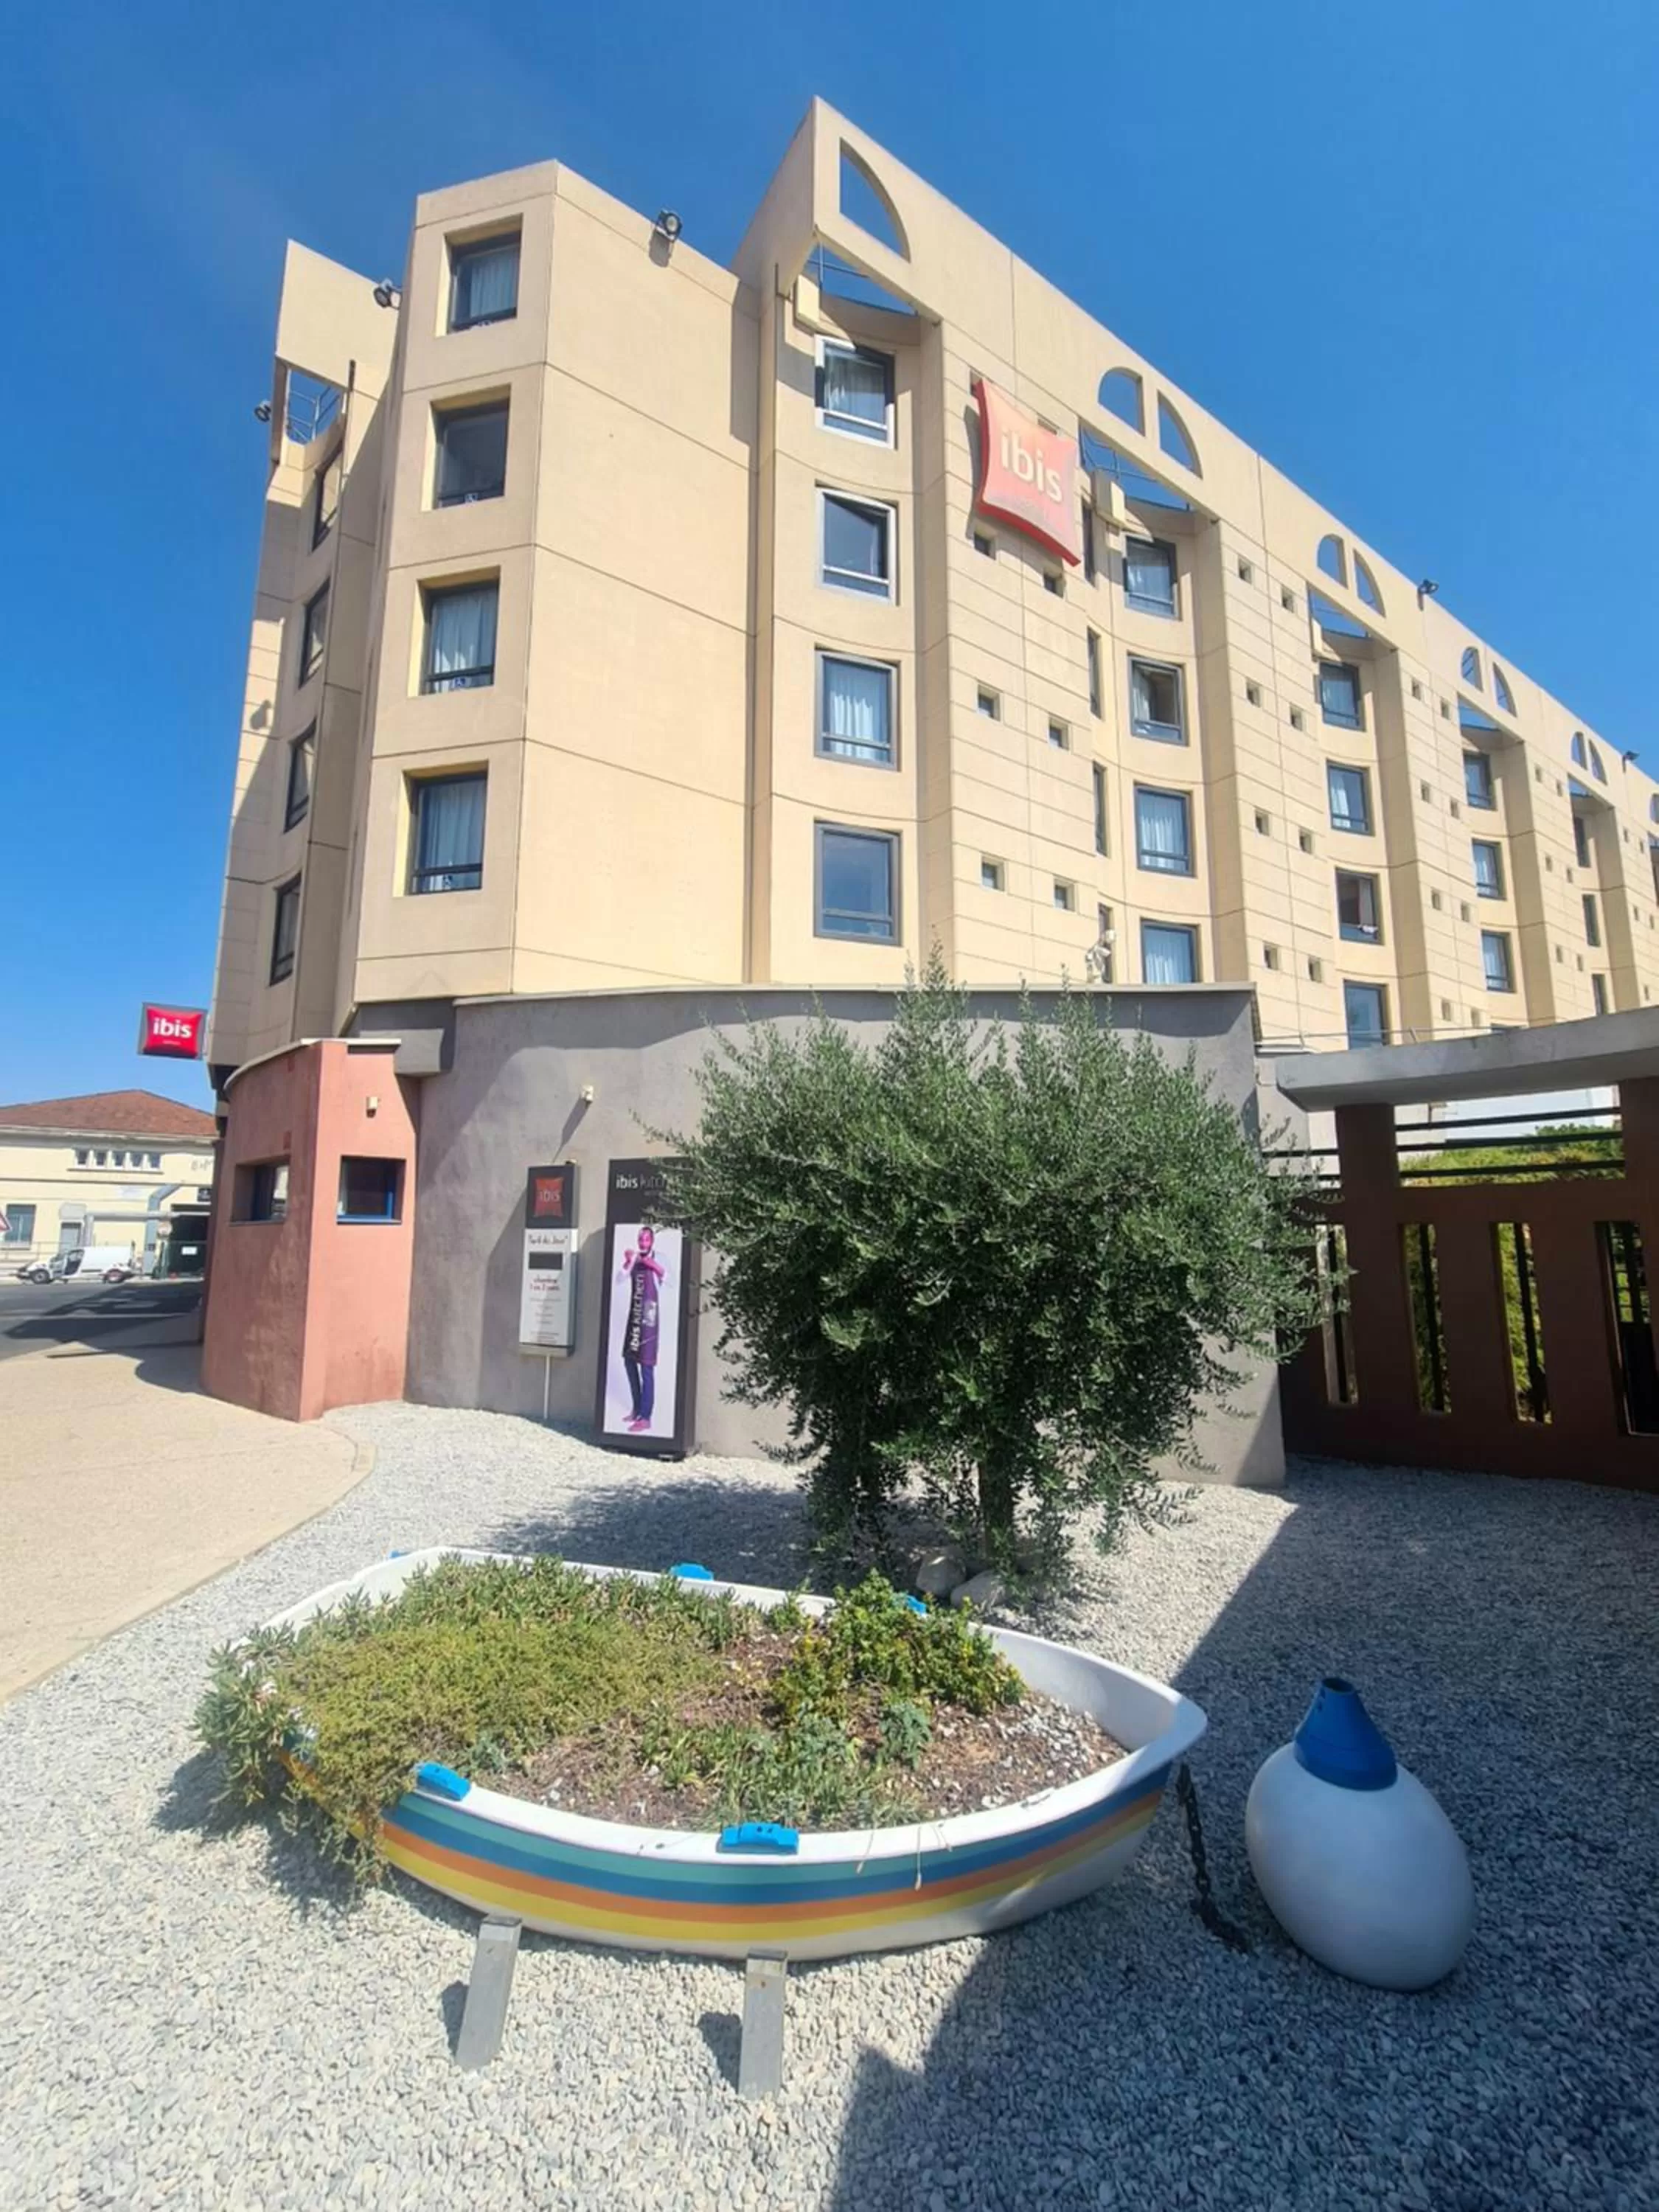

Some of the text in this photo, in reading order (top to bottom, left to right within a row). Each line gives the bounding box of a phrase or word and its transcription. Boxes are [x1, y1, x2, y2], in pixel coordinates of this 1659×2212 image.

[1000, 428, 1063, 504] ibis
[153, 1017, 192, 1038] ibis
[616, 1173, 638, 1189] ibis
[630, 1273, 644, 1352] ibis kitchen
